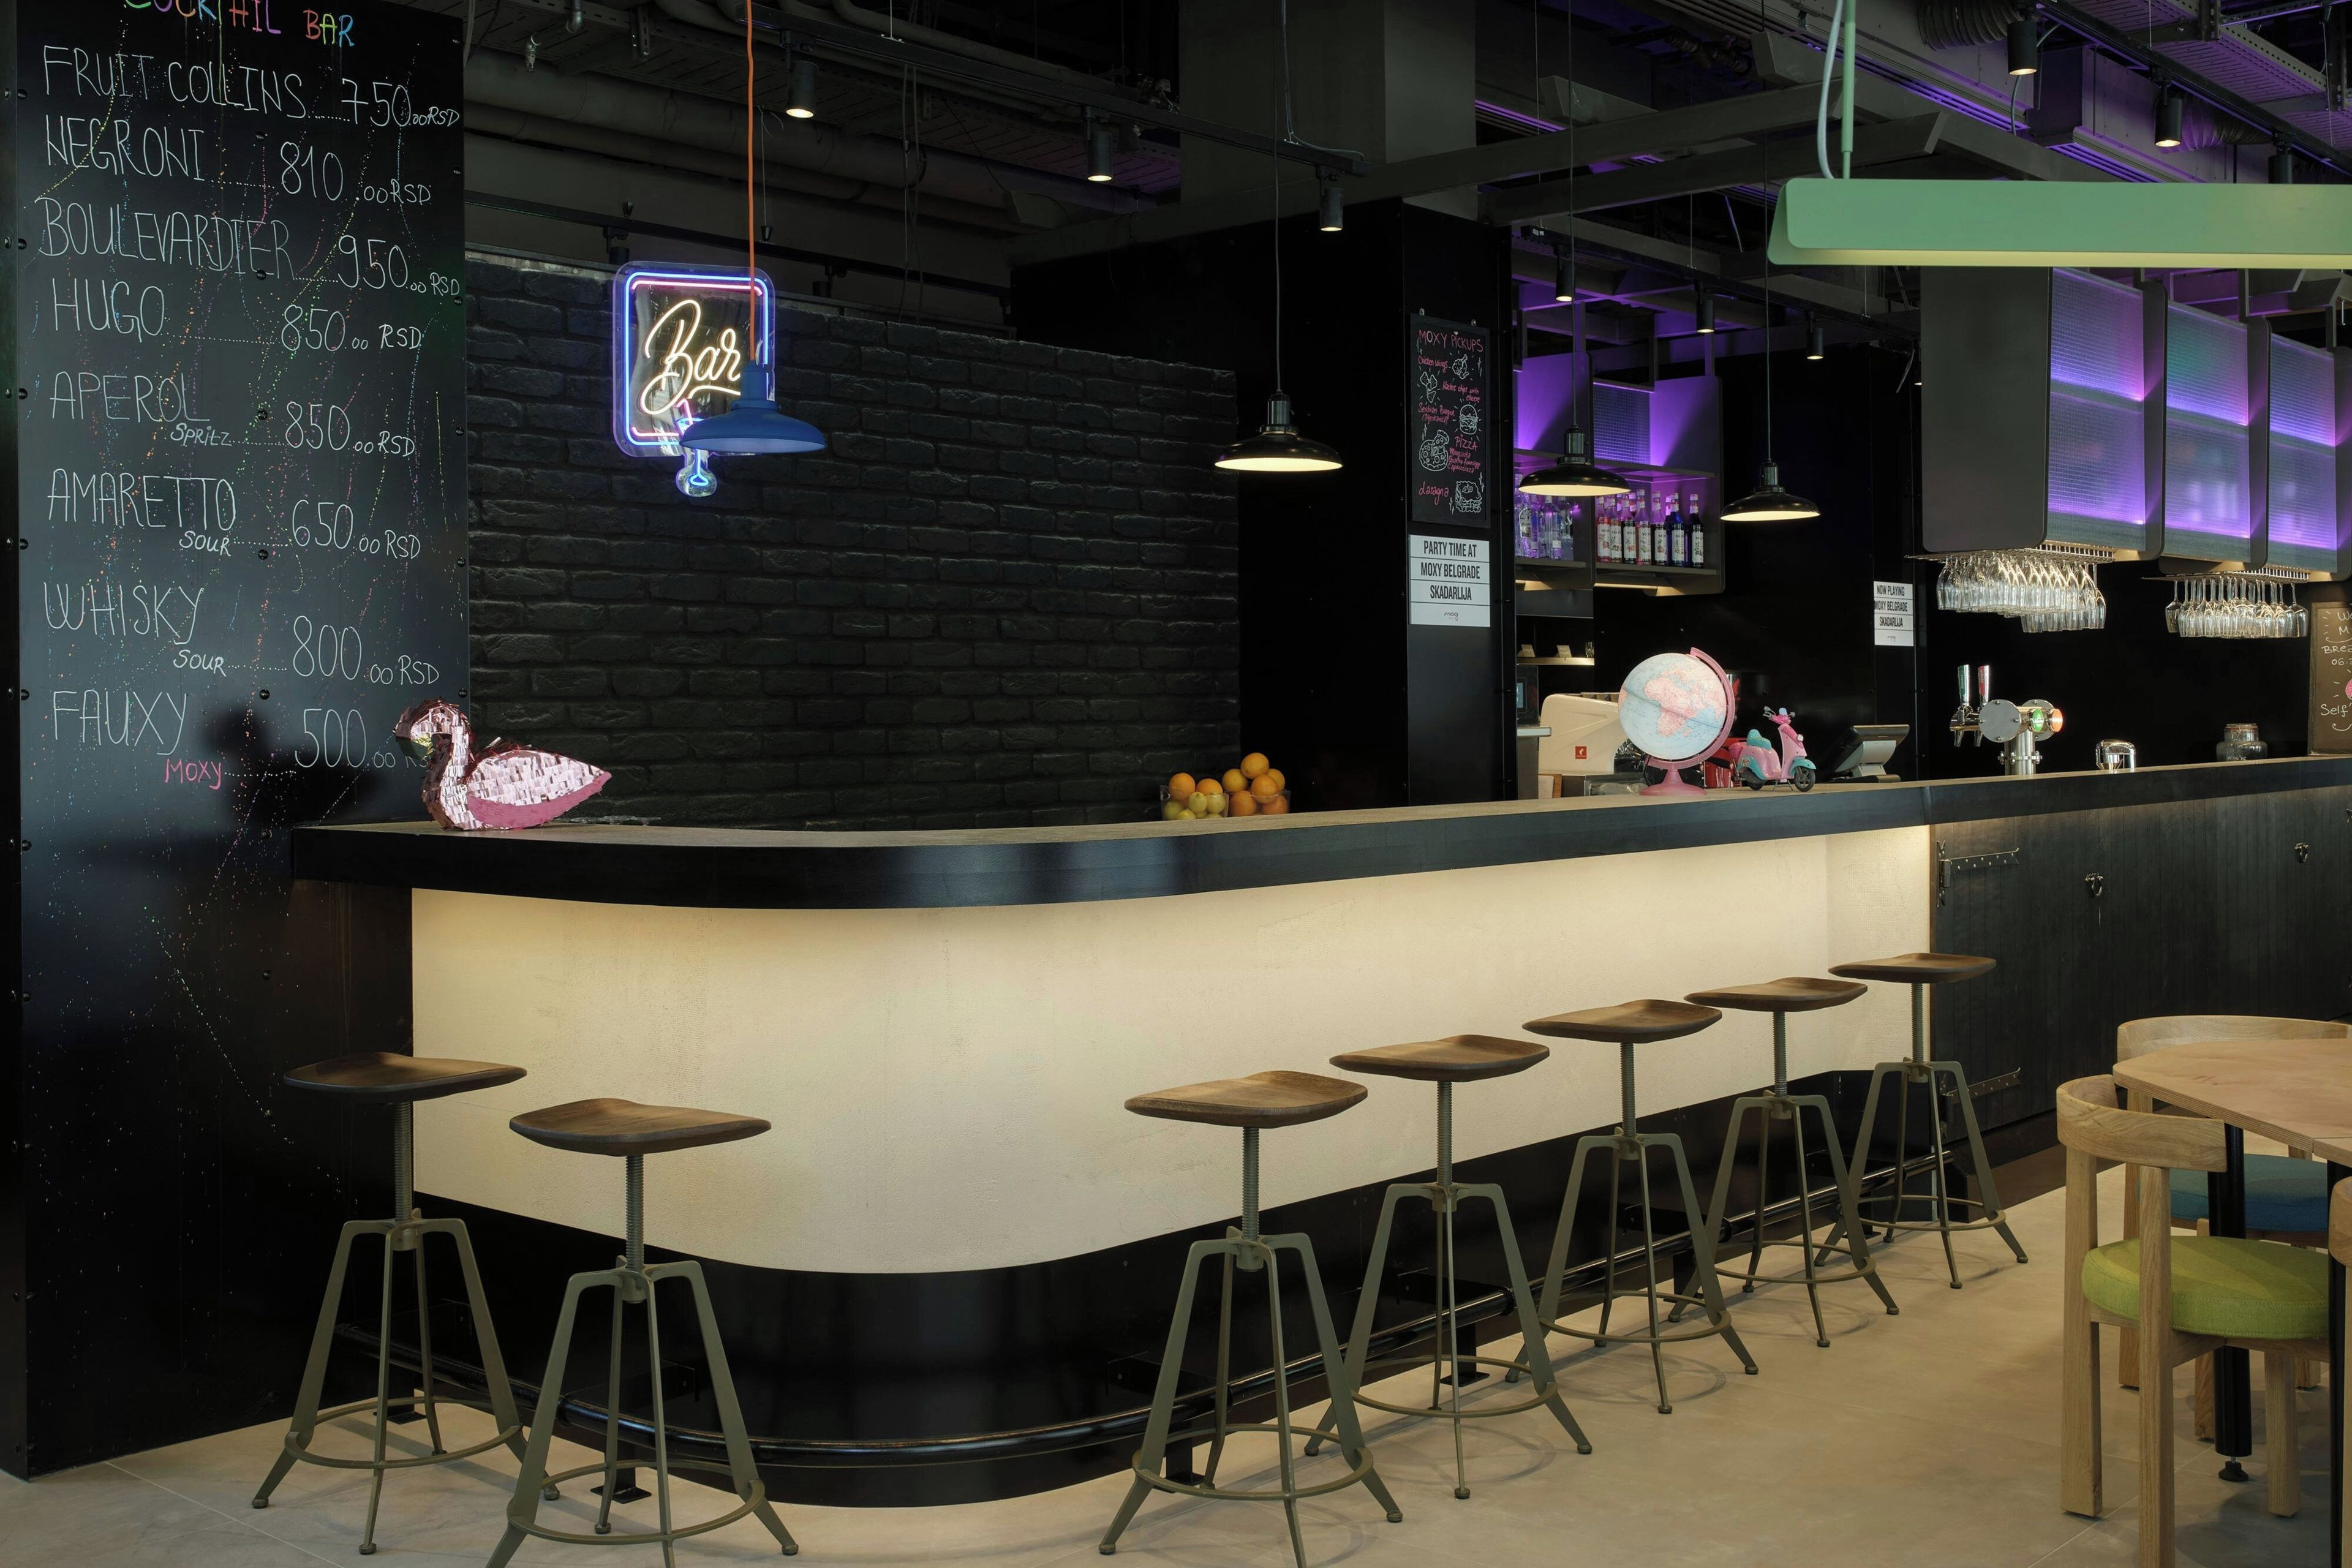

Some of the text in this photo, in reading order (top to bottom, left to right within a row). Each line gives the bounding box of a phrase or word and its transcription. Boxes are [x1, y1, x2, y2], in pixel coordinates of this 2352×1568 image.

[303, 9, 355, 48] BAR
[44, 45, 154, 100] FRUIT
[168, 61, 306, 118] COLLINS
[46, 115, 205, 181] NEGRONI
[35, 198, 295, 280] BOULEVARDIER
[53, 278, 165, 343] HUGO
[379, 323, 422, 350] RSD
[639, 299, 741, 415] Bar
[1419, 330, 1447, 349] MOXY
[50, 372, 210, 422] APEROL
[48, 469, 236, 531] AMARETTO
[179, 530, 232, 557] SOUR
[1423, 540, 1477, 557] PARTY TIME AT
[1420, 562, 1480, 579] MOXY BELGRADE
[1430, 584, 1472, 600] SKADARLIJA
[1874, 600, 1908, 612] MOXY BELGRADE
[1877, 585, 1905, 596] NOW PLAYING
[44, 582, 205, 645] WHISKY
[173, 649, 227, 677] SOUR
[53, 689, 187, 755] FAUXY
[164, 758, 222, 790] MOXY
